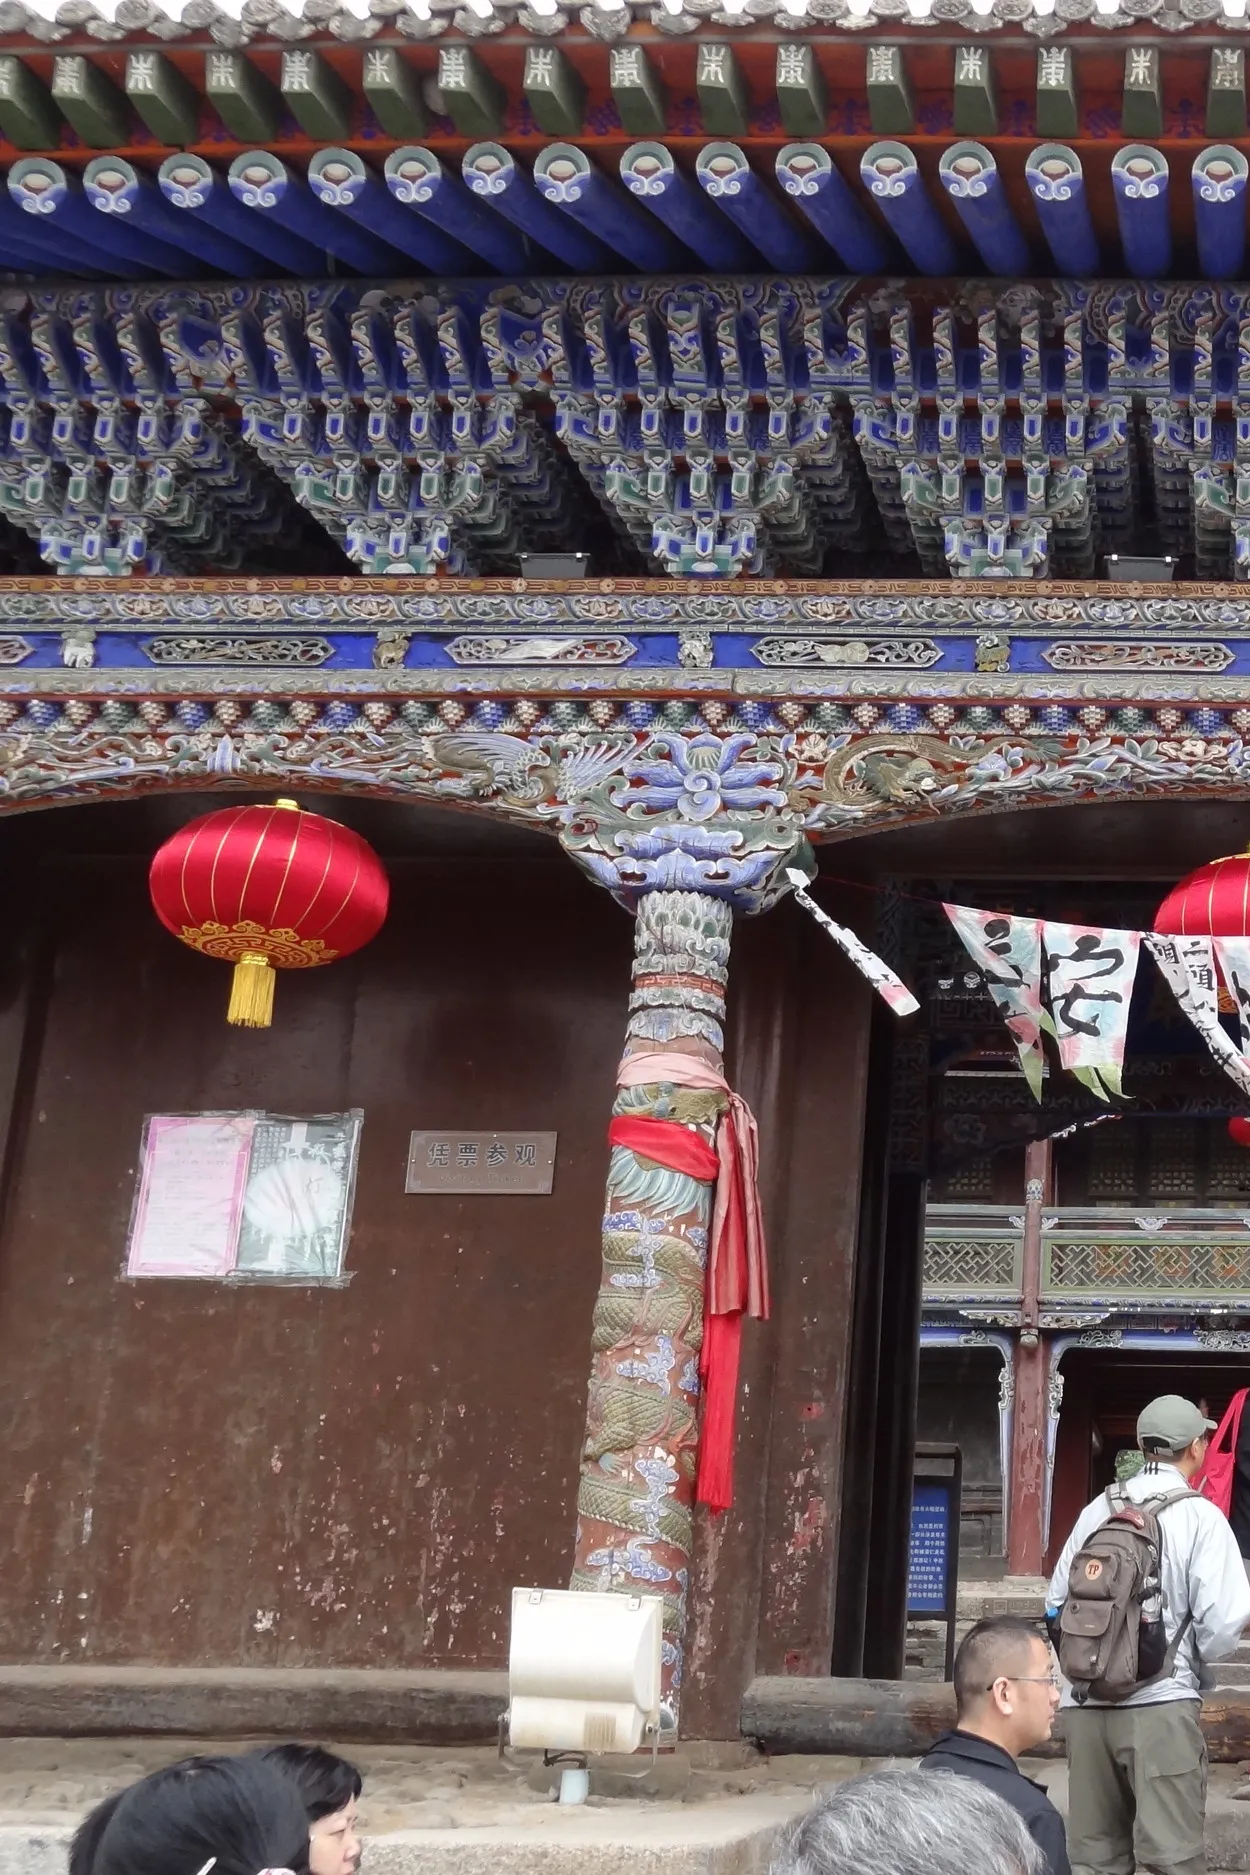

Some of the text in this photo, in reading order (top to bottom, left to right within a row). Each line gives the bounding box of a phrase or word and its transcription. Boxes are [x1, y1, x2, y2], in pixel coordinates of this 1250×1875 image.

[428, 1142, 537, 1168] 凭票参观
[1088, 1564, 1100, 1575] TP
